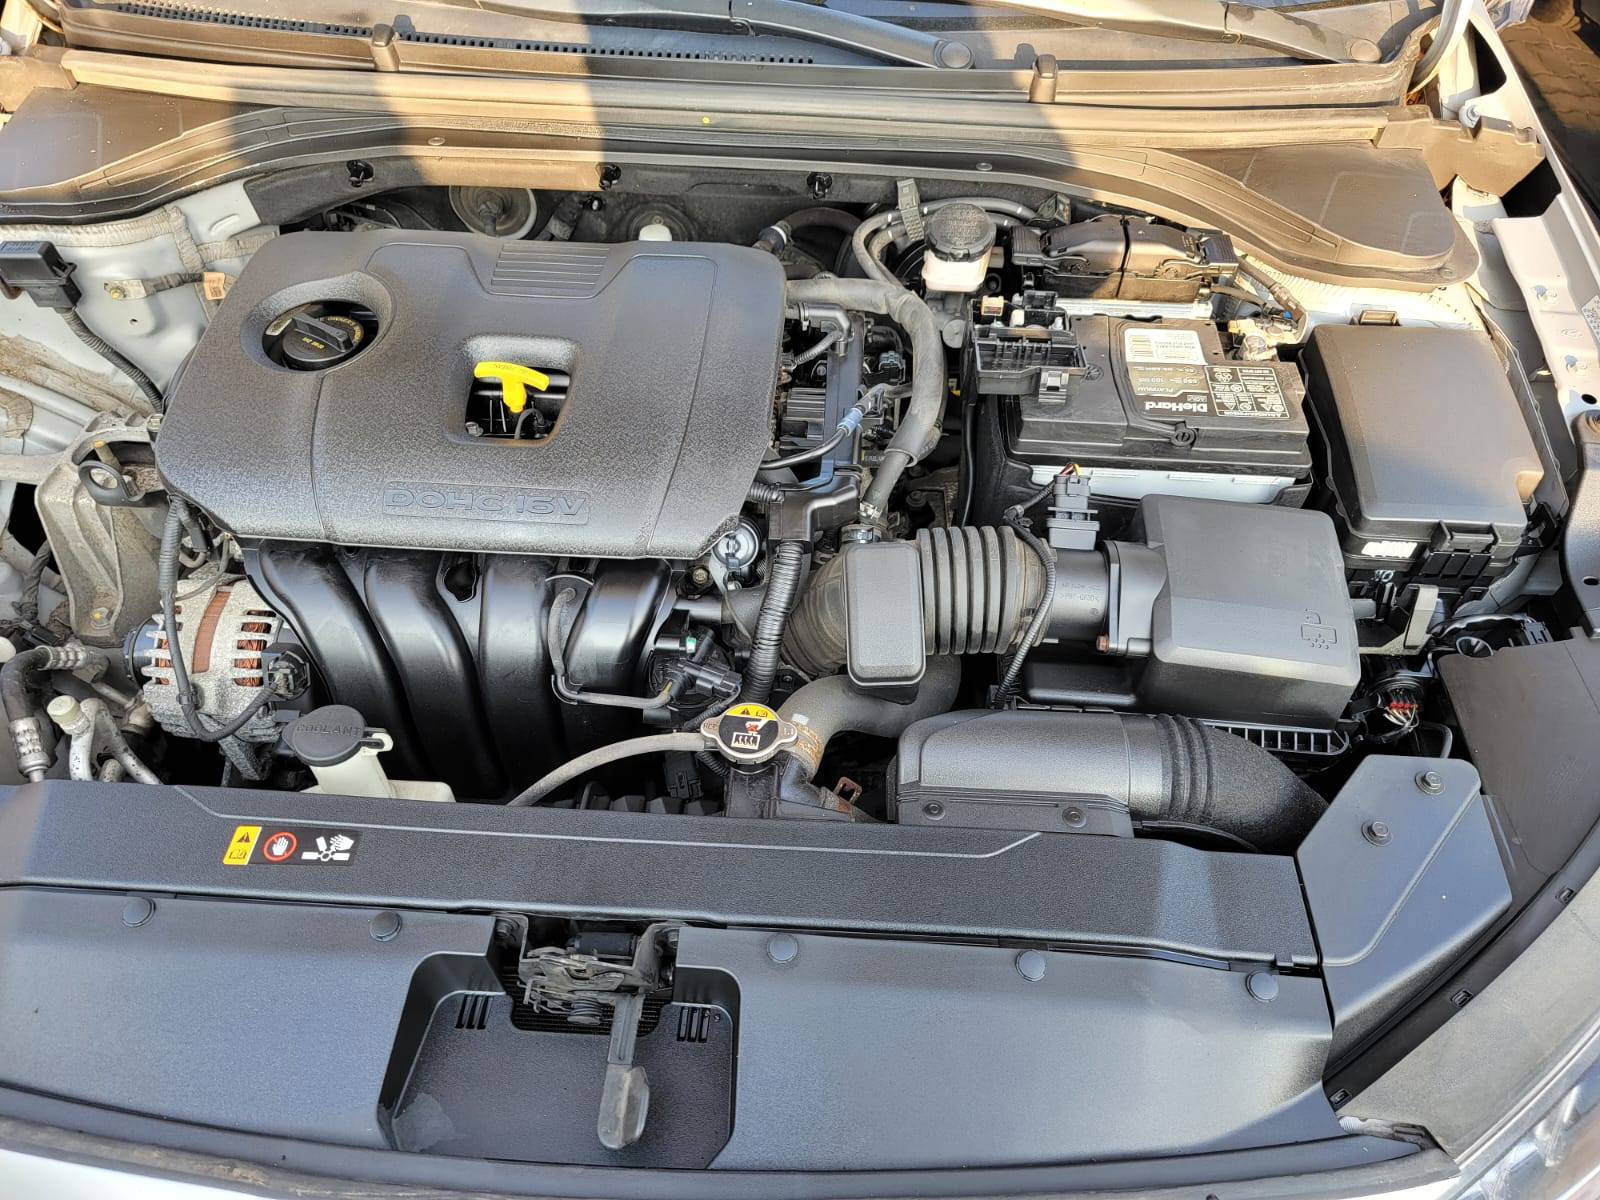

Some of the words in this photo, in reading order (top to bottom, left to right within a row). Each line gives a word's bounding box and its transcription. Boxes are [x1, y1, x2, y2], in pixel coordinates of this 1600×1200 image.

[1145, 401, 1208, 413] DieHard
[383, 489, 504, 511] DOHC
[516, 495, 586, 515] 16V
[296, 724, 362, 737] COOLANT
